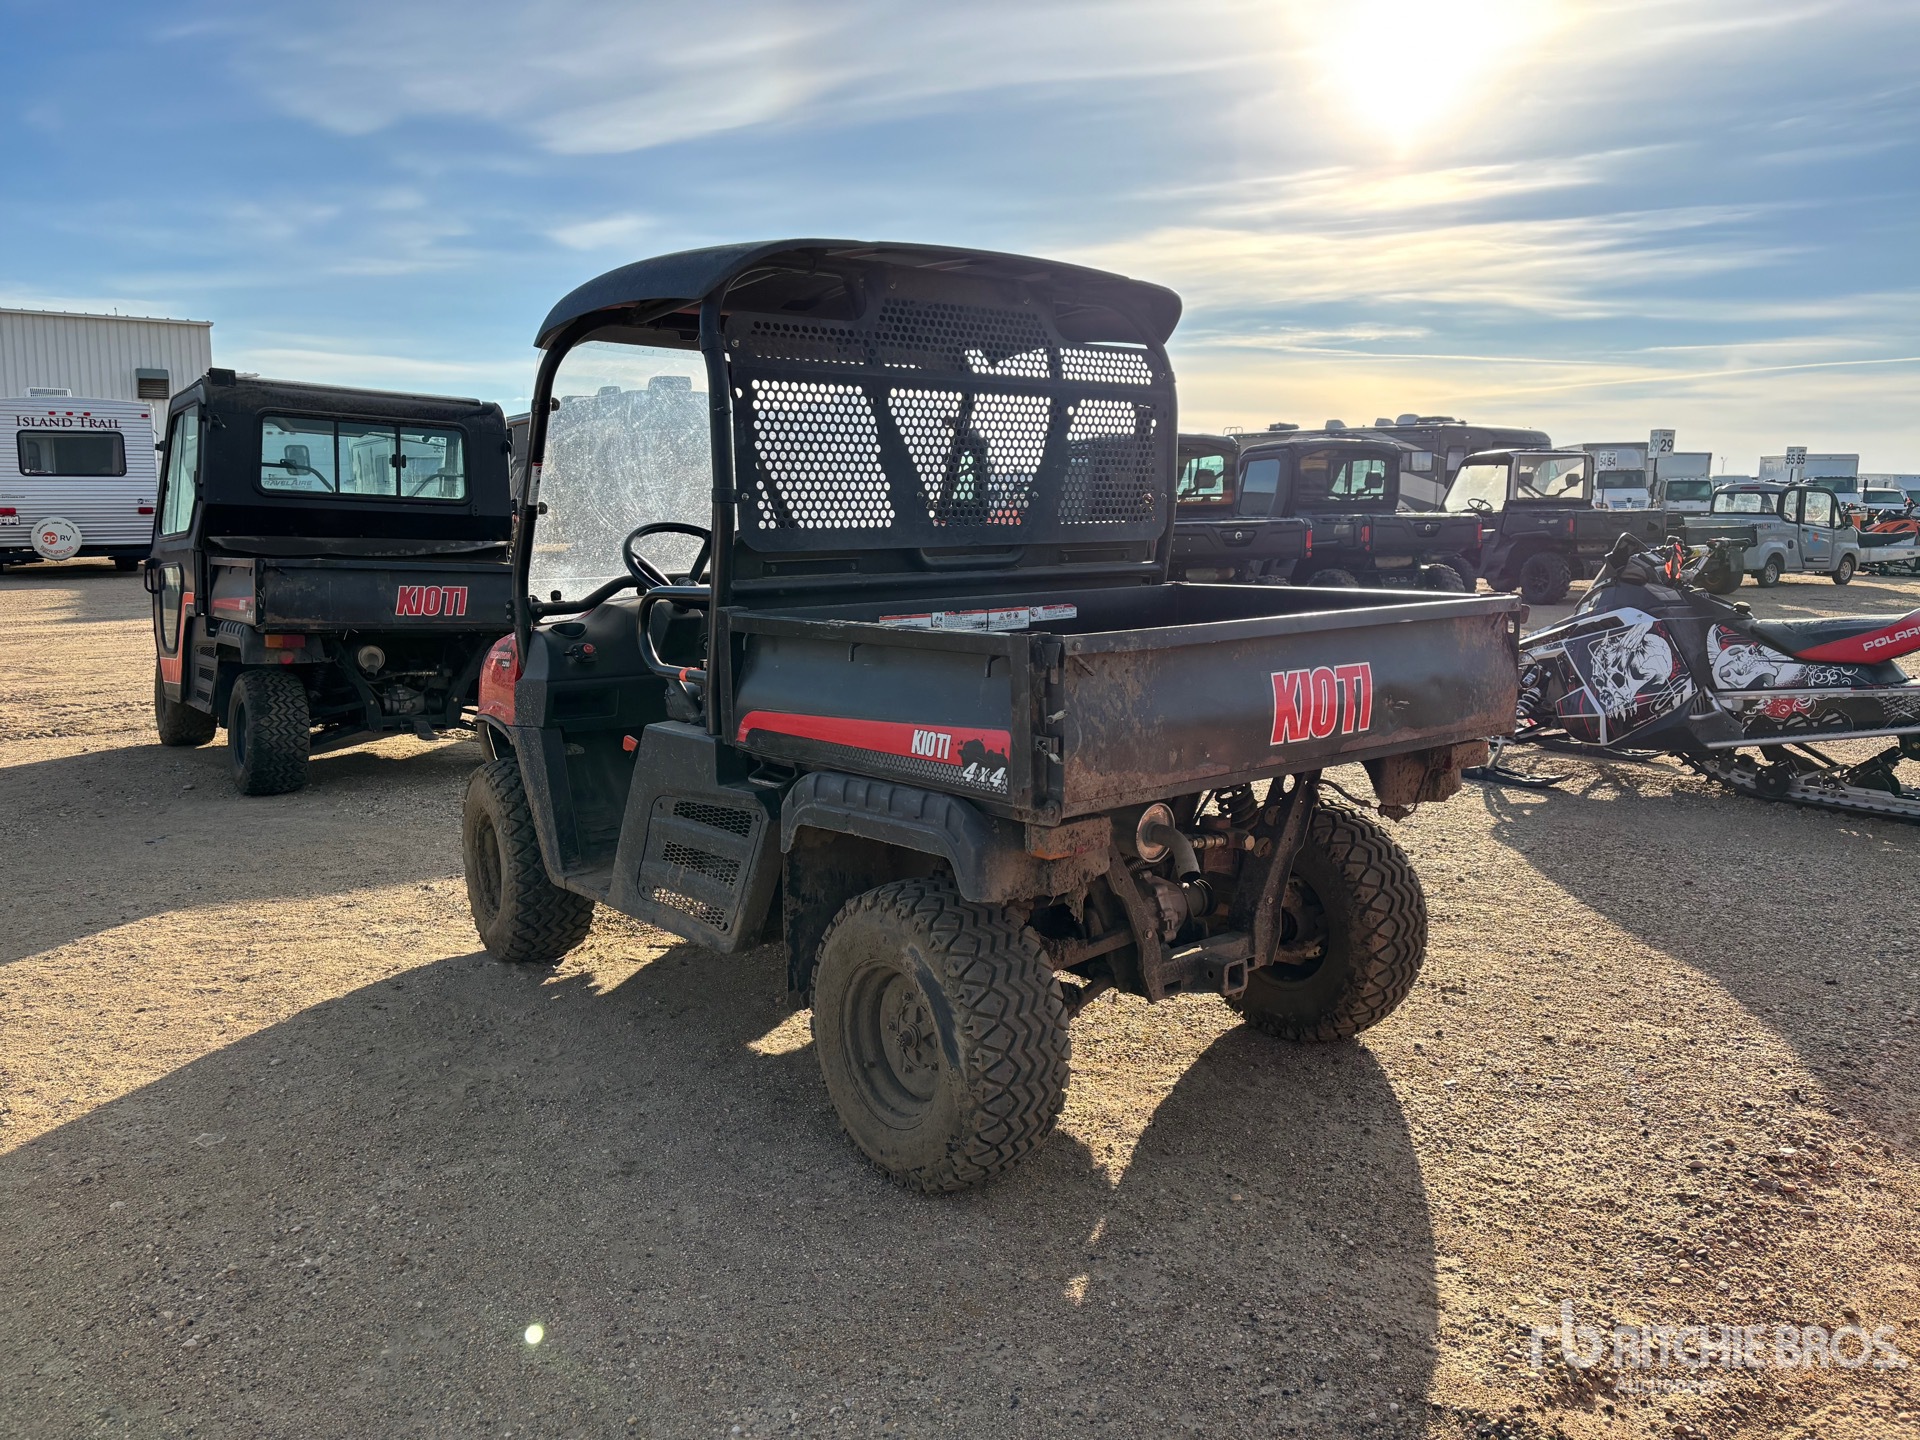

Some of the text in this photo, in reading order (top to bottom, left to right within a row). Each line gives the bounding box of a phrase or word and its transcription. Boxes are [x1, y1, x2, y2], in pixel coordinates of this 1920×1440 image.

[16, 415, 122, 429] ISLAND TRAIL
[1660, 438, 1674, 452] 29
[1607, 456, 1616, 467] 54
[1785, 454, 1796, 465] 55
[1796, 454, 1806, 465] 55
[43, 534, 72, 545] go RV
[395, 585, 468, 616] KIOTI
[1270, 661, 1373, 746] KIOTI
[911, 729, 952, 760] KIOTI
